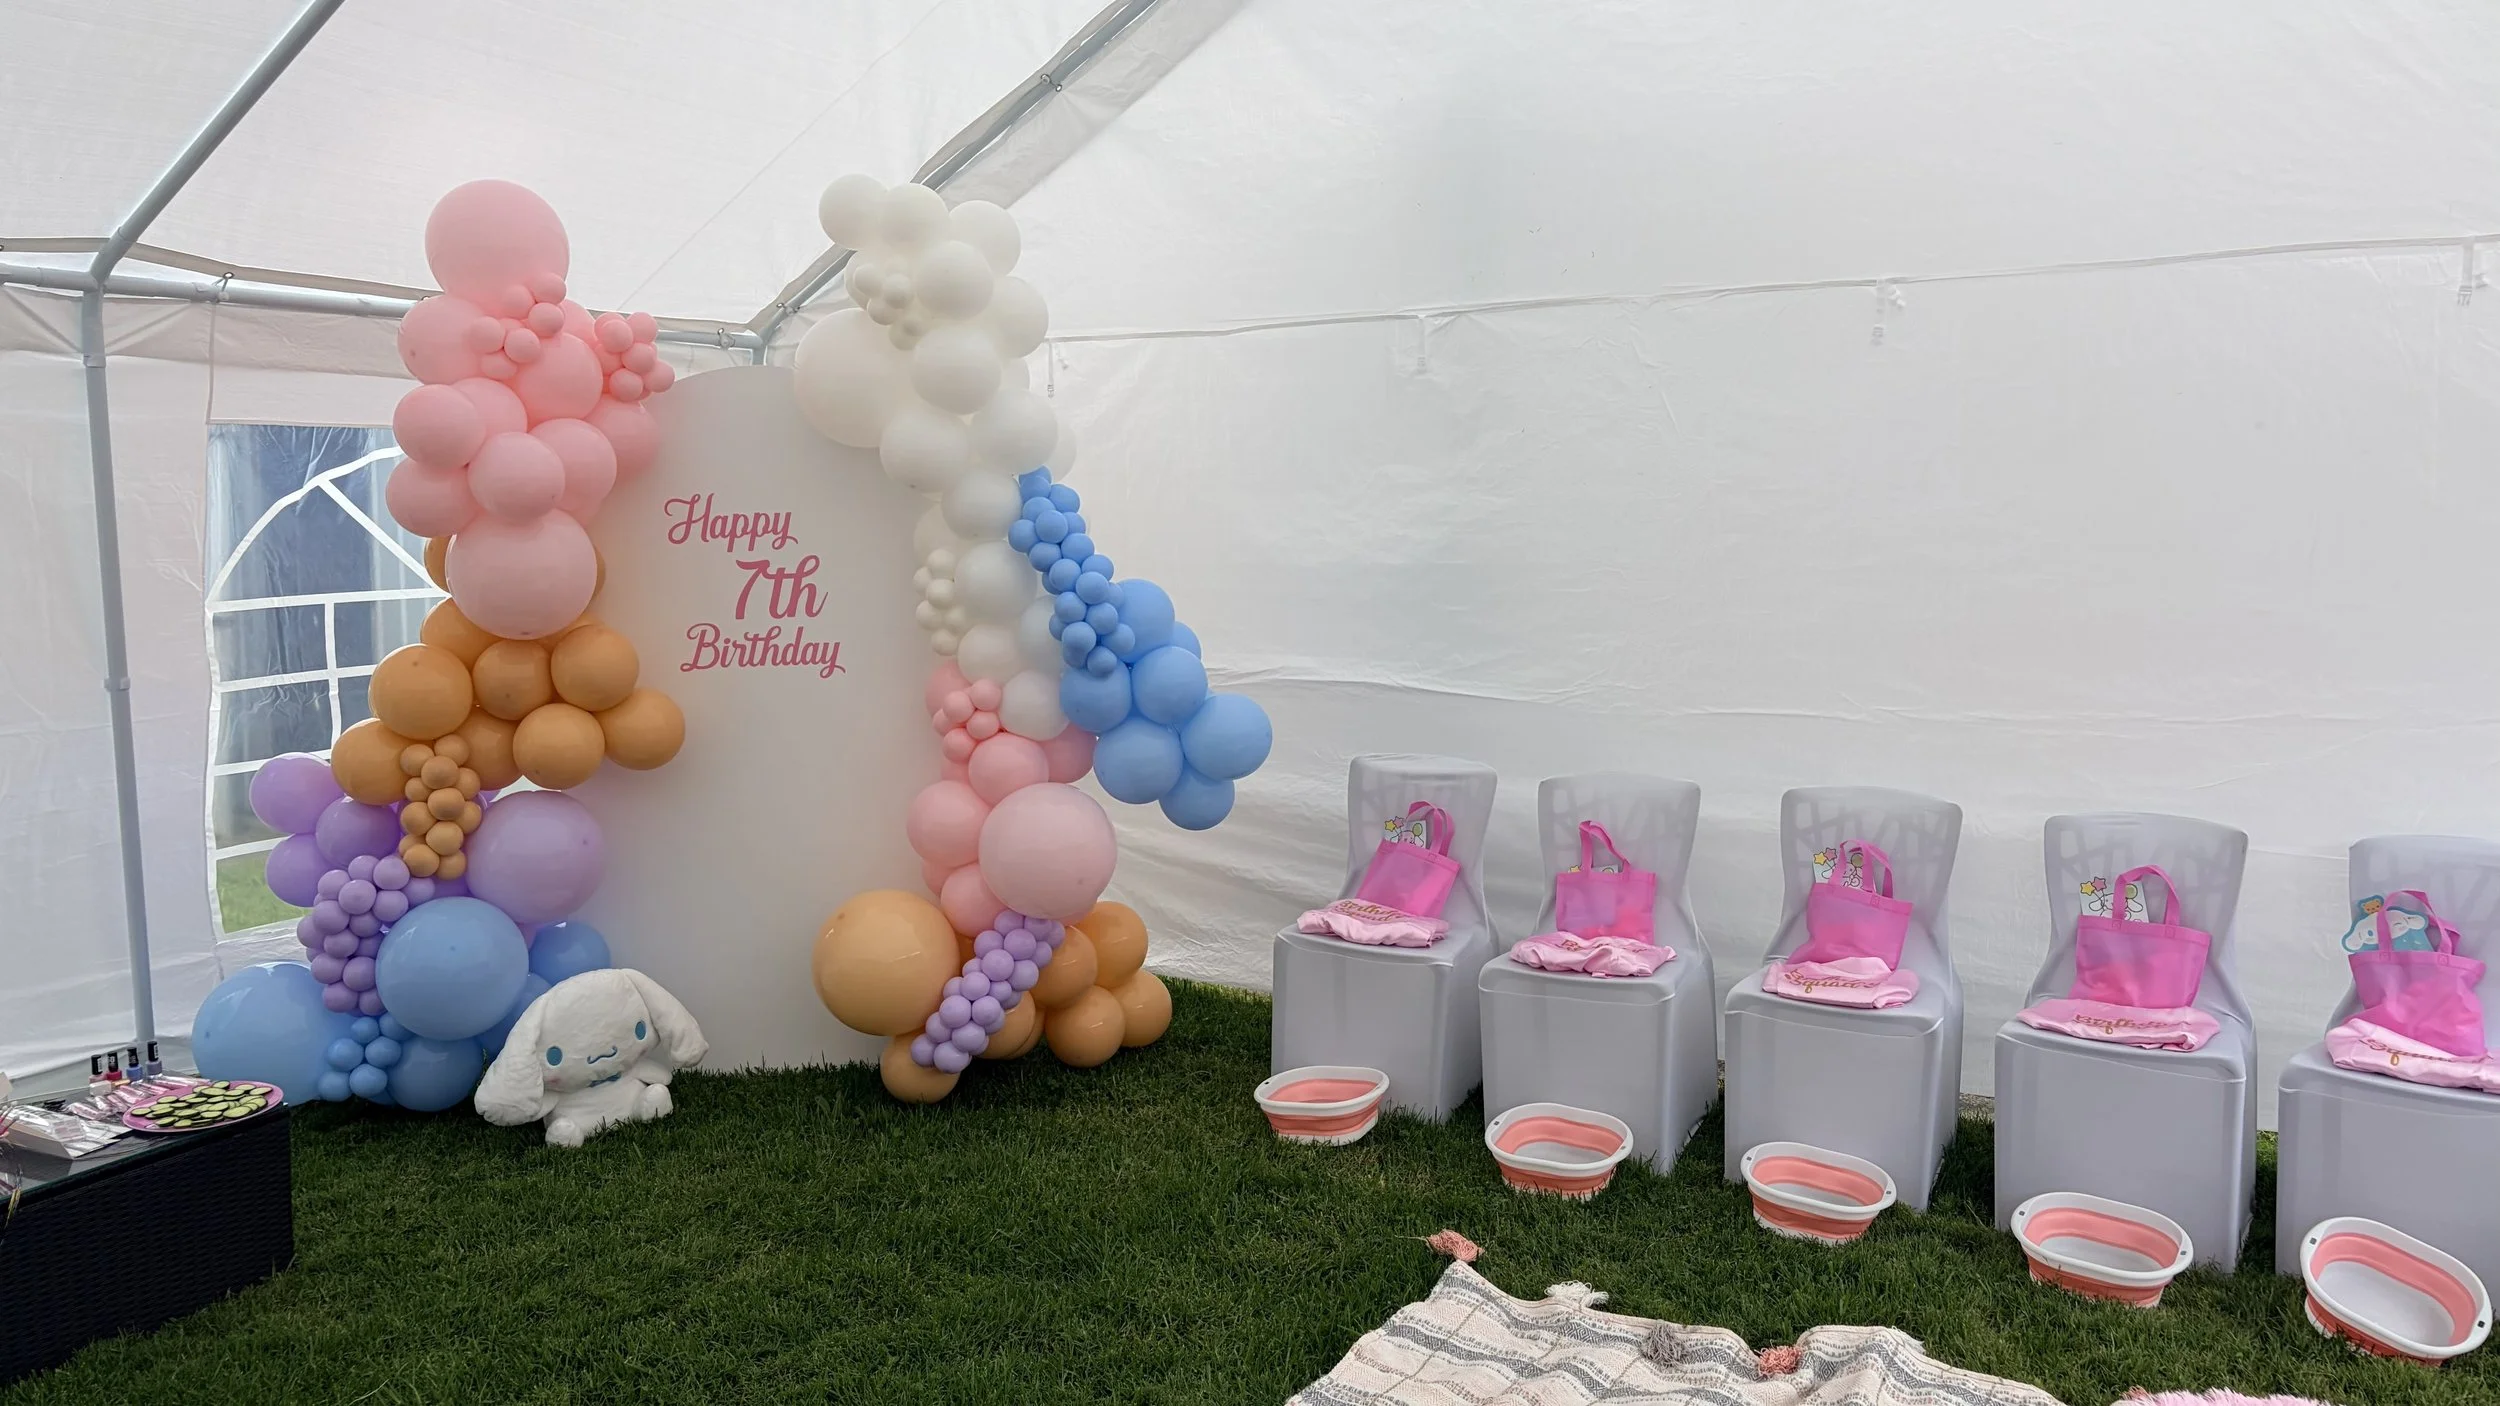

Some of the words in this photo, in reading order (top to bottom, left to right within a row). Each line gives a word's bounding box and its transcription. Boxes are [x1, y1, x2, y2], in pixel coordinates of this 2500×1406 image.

[664, 493, 798, 553] Happy
[735, 555, 828, 620] 7th
[680, 623, 846, 679] Birthday
